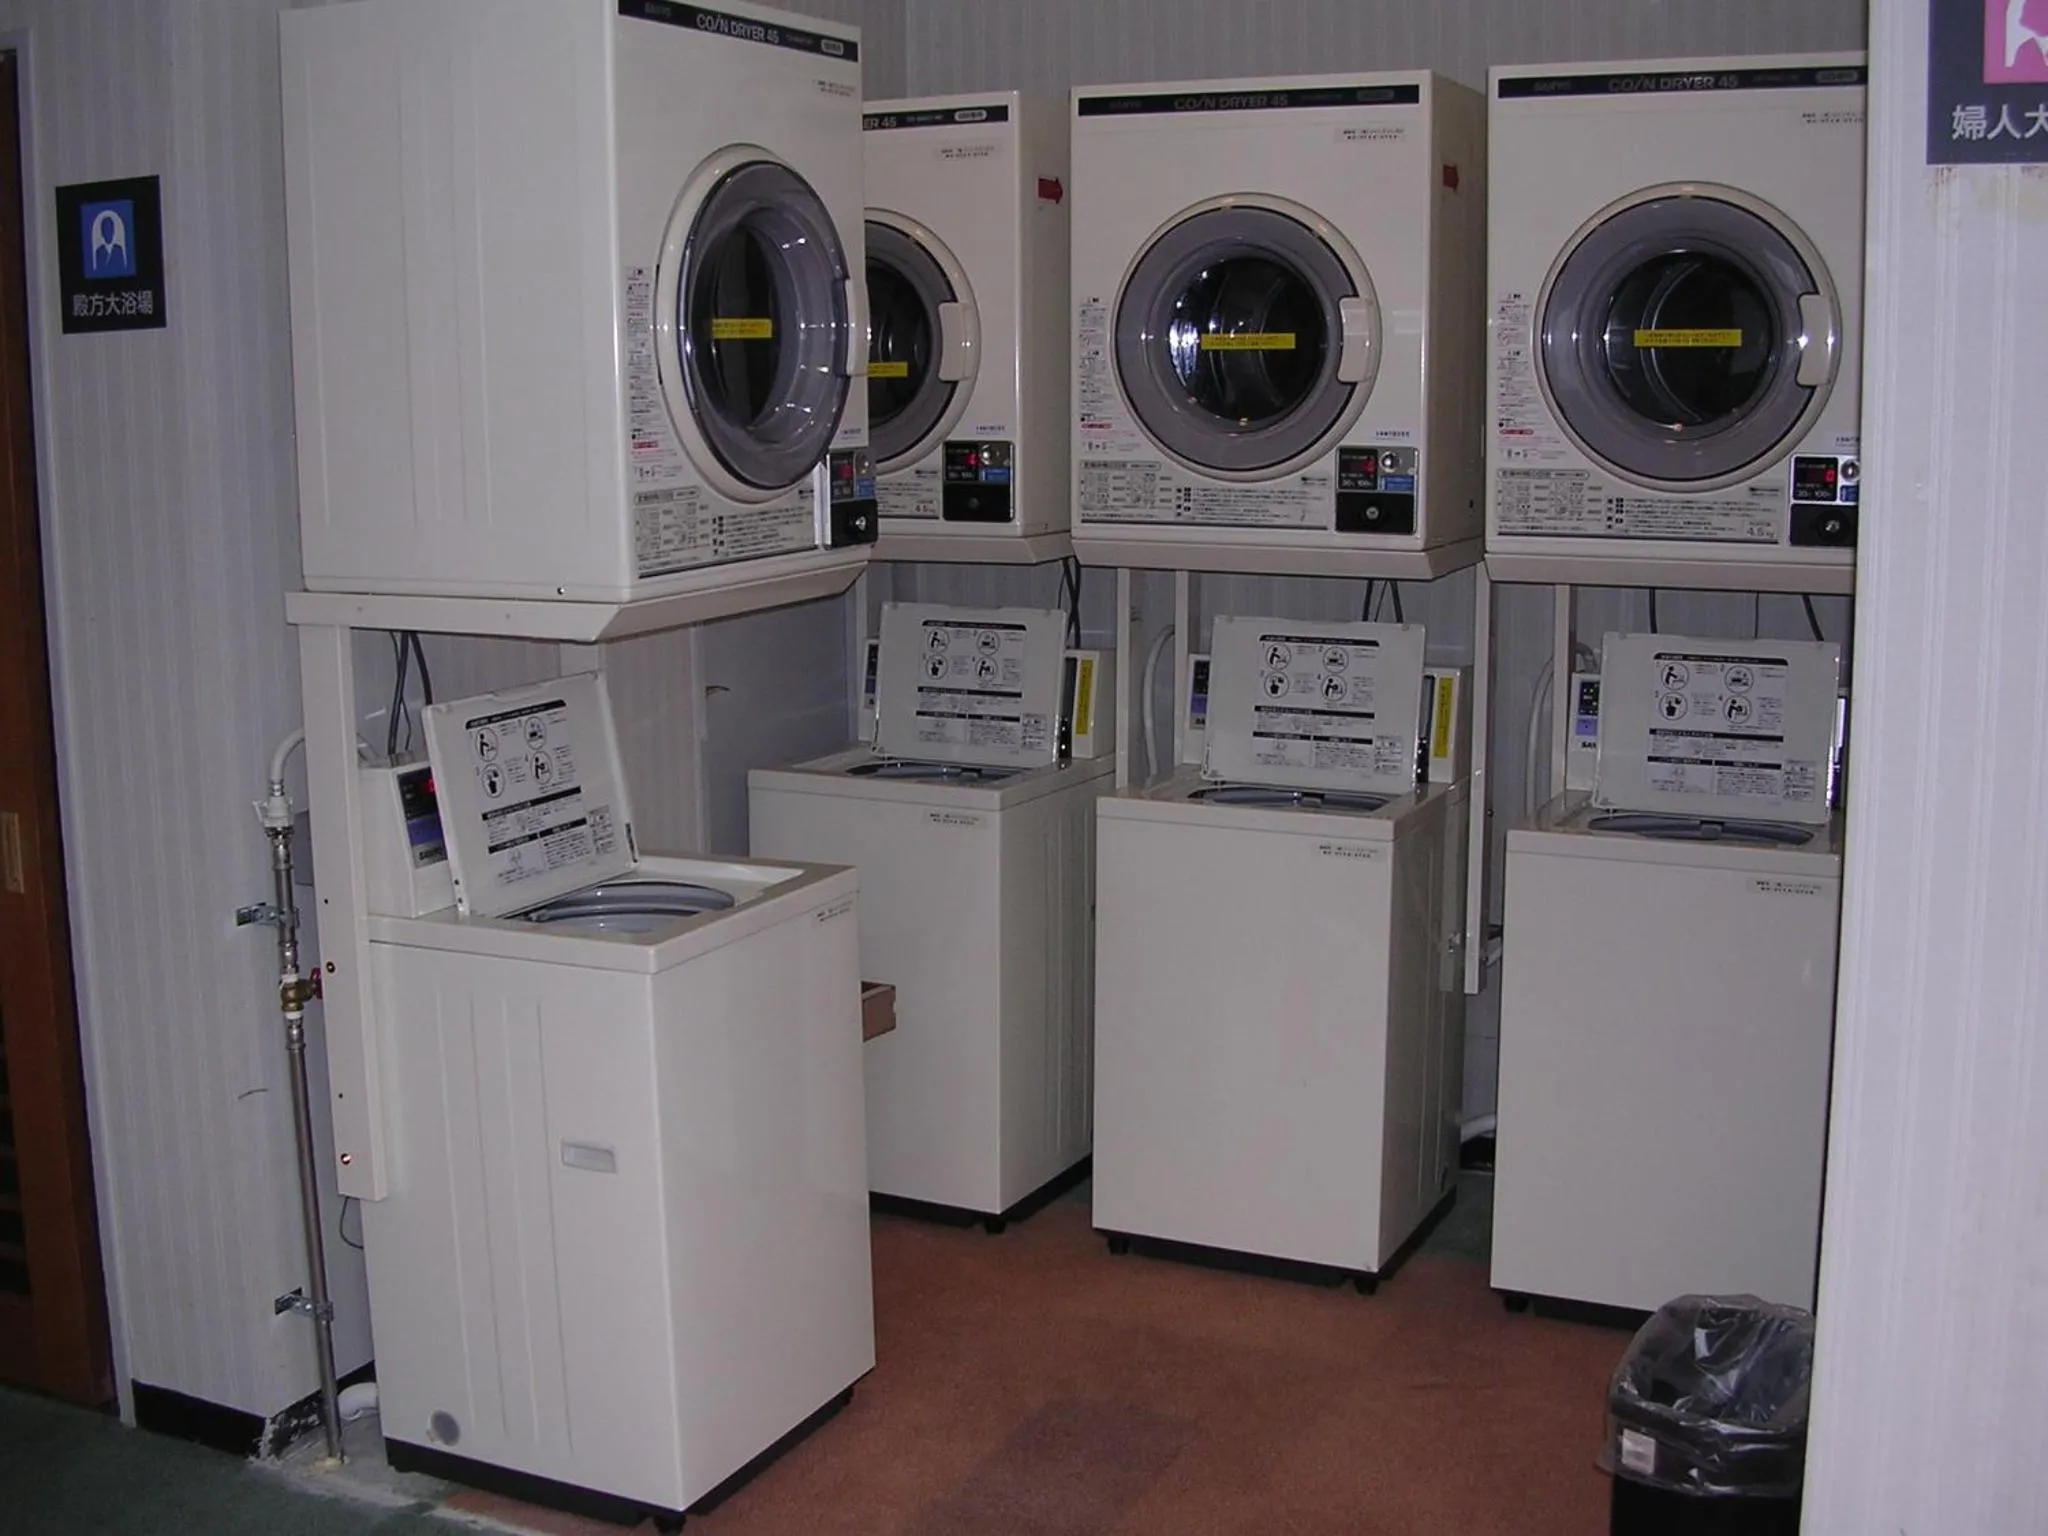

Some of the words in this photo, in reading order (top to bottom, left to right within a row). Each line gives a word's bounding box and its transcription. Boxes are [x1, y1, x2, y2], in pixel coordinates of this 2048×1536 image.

[730, 20, 765, 42] DRYER
[1660, 76, 1715, 90] DRYER
[1718, 75, 1739, 89] 45
[1219, 94, 1267, 109] DRYER
[1270, 94, 1288, 106] 45
[72, 290, 153, 317] 殿方大浴場
